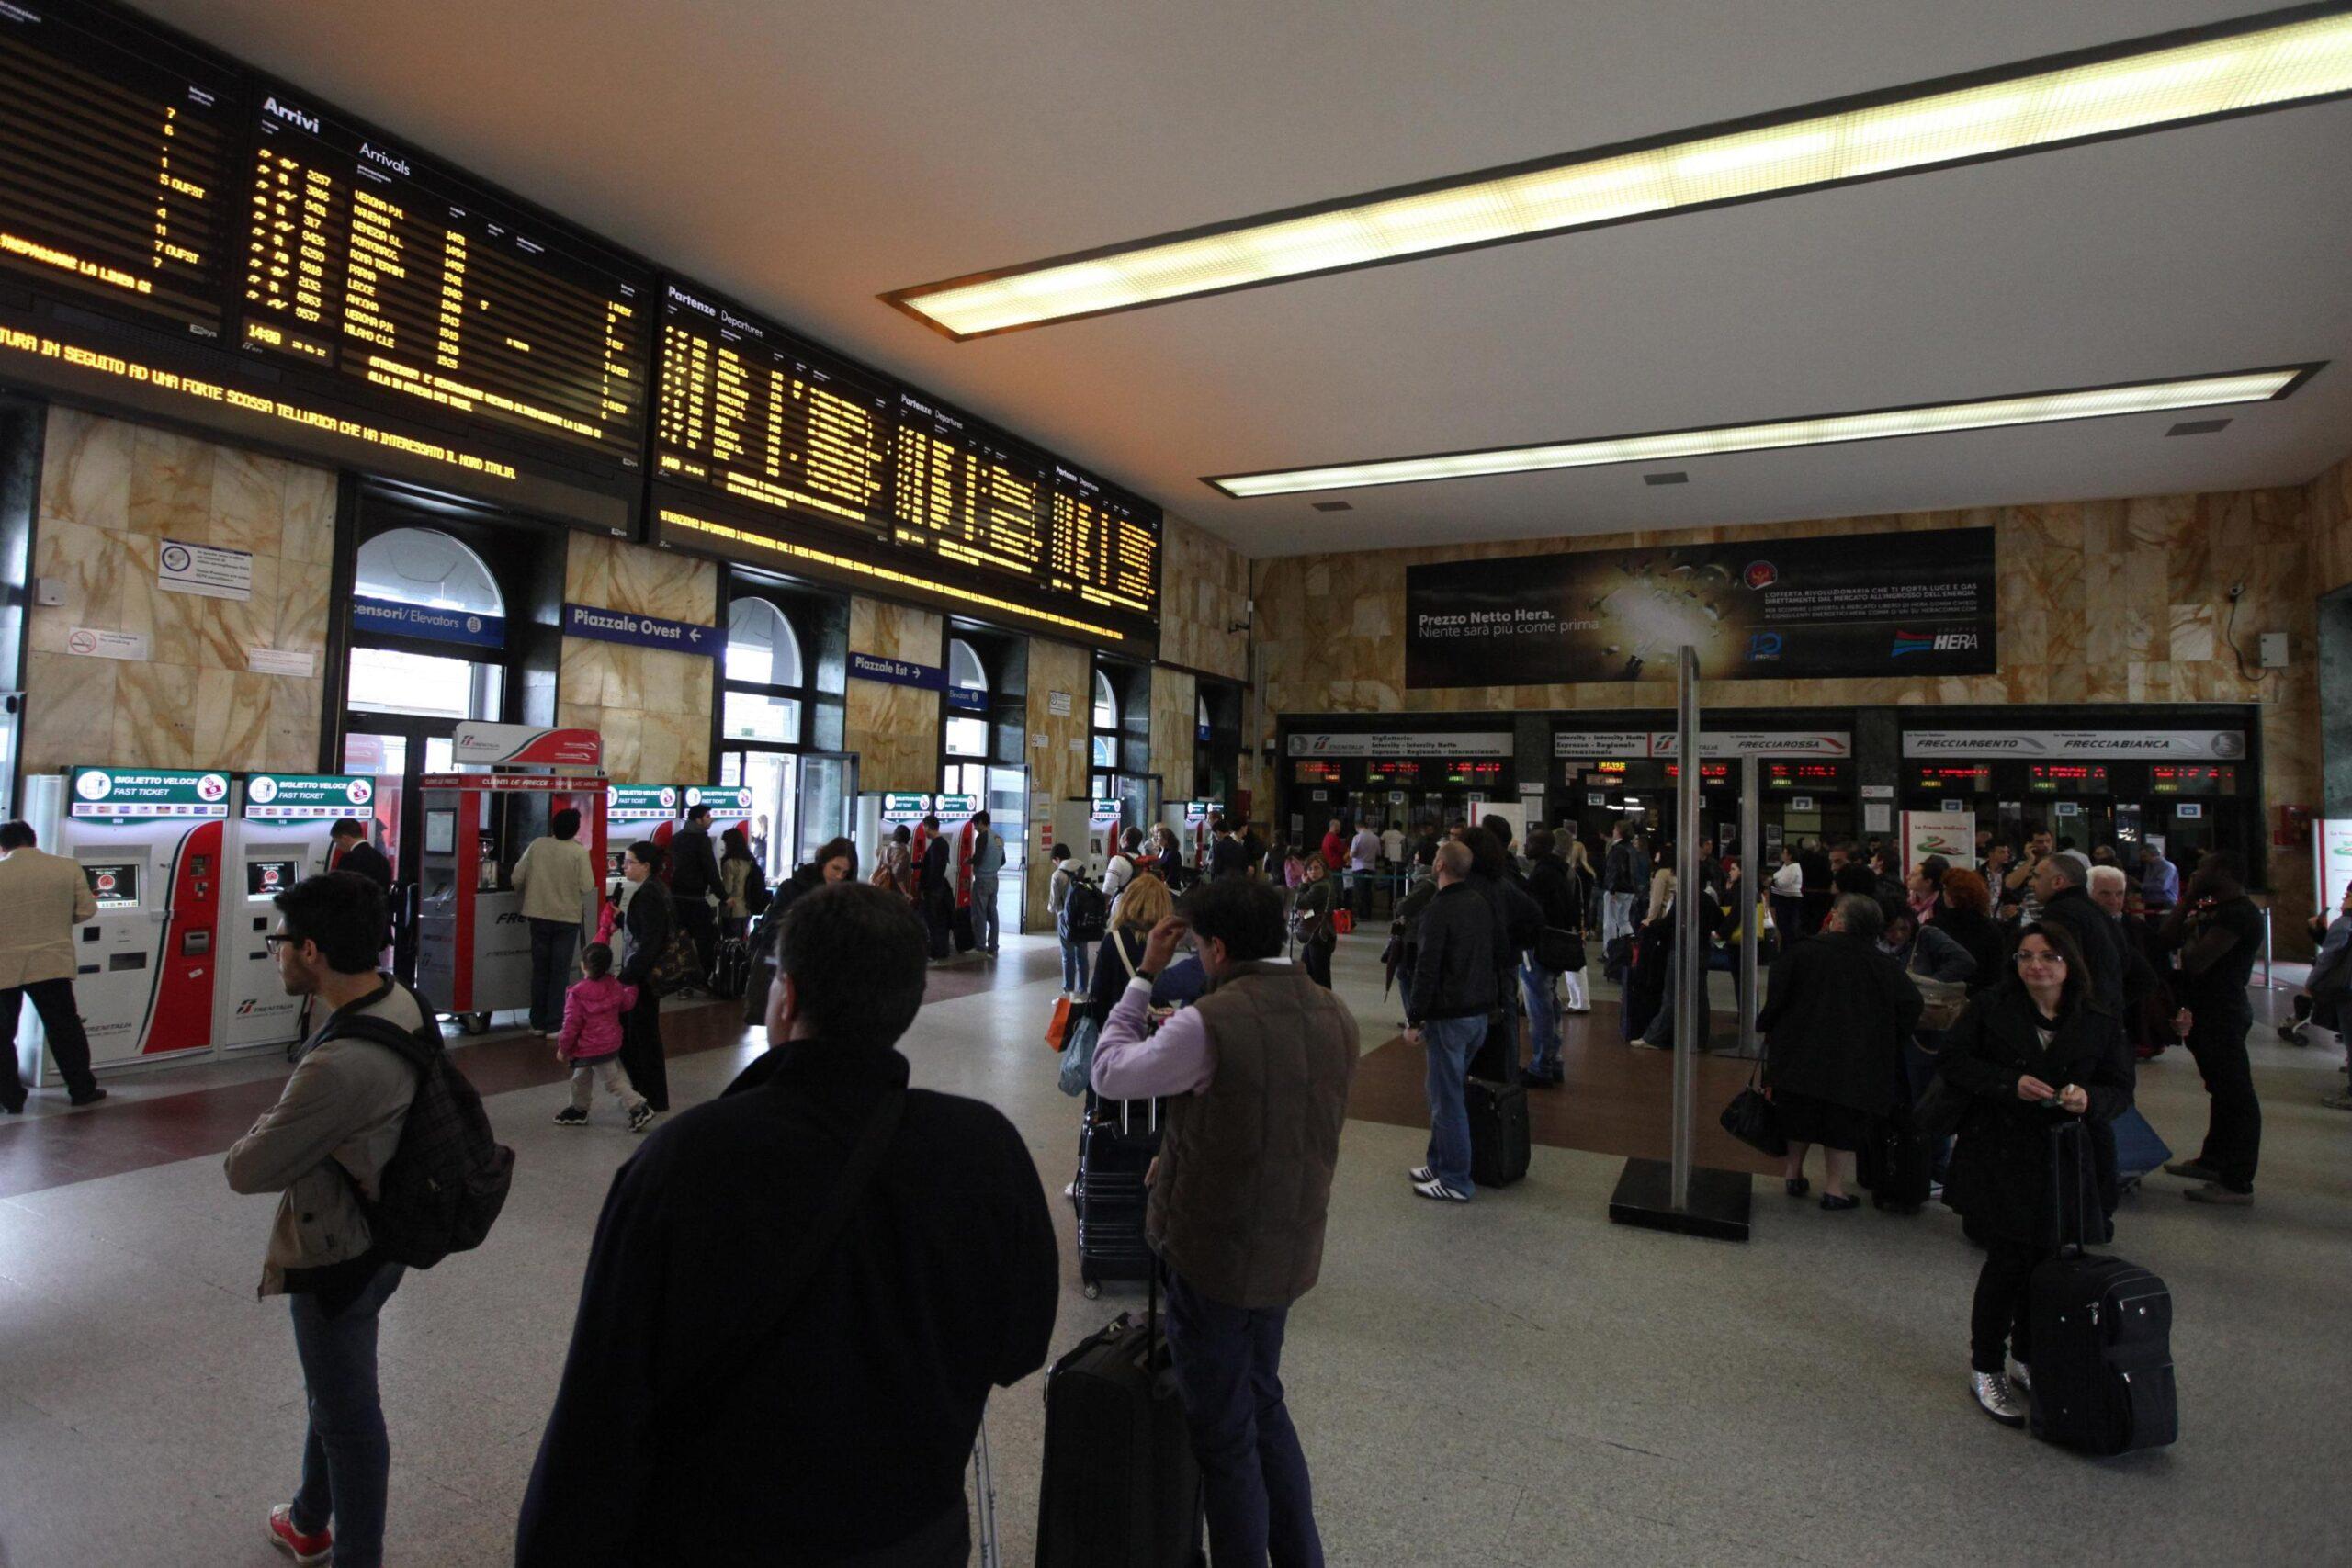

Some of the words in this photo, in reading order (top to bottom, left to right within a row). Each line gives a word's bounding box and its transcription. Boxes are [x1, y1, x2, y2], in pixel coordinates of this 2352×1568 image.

[164, 125, 174, 136] 6
[264, 97, 320, 134] Arrivi
[359, 142, 410, 176] Arrivals
[162, 157, 168, 169] 1
[303, 215, 322, 229] 317
[80, 261, 97, 277] LA
[349, 263, 377, 282] PARMA
[348, 277, 375, 297] LECCE
[346, 294, 379, 312] ANCONA
[669, 285, 717, 317] Partenze
[721, 310, 763, 338] Departures
[42, 339, 61, 359] IN
[64, 347, 127, 375] SEGUITO
[130, 364, 149, 382] AD
[153, 369, 178, 389] UNA
[182, 378, 224, 401] FORTE
[227, 390, 273, 414] SCOSSA
[276, 402, 337, 432] TELLURICA
[340, 422, 360, 435] CHE
[363, 426, 378, 441] HA
[380, 432, 444, 461] INTERESSATO
[447, 448, 457, 463] IL
[459, 452, 482, 473] NORD
[900, 393, 933, 416] Partenze
[935, 409, 963, 429] Departures
[1804, 588, 1869, 597] RIVOLUZIONARIA
[1901, 584, 1927, 592] PORTA
[1764, 596, 1815, 604] DIRETTAMENTE
[412, 610, 459, 628] Elevators
[574, 608, 638, 634] Piazzale
[641, 622, 682, 639] Ovest
[1419, 615, 1466, 626] Prezzo
[1470, 612, 1510, 624] Netto
[1514, 609, 1555, 622] Hera.
[1419, 626, 1460, 638] Niente
[1463, 624, 1489, 636] sarà
[1492, 623, 1513, 637] più
[1516, 622, 1555, 634] come
[1933, 634, 1978, 650] HERA
[855, 656, 893, 674] Piazzale
[895, 664, 907, 677] Est
[114, 776, 162, 785] BIGLIETTO
[163, 777, 198, 786] VELOCE
[279, 781, 318, 789] BIGLIETTO
[254, 1004, 293, 1012] TRENITALIA
